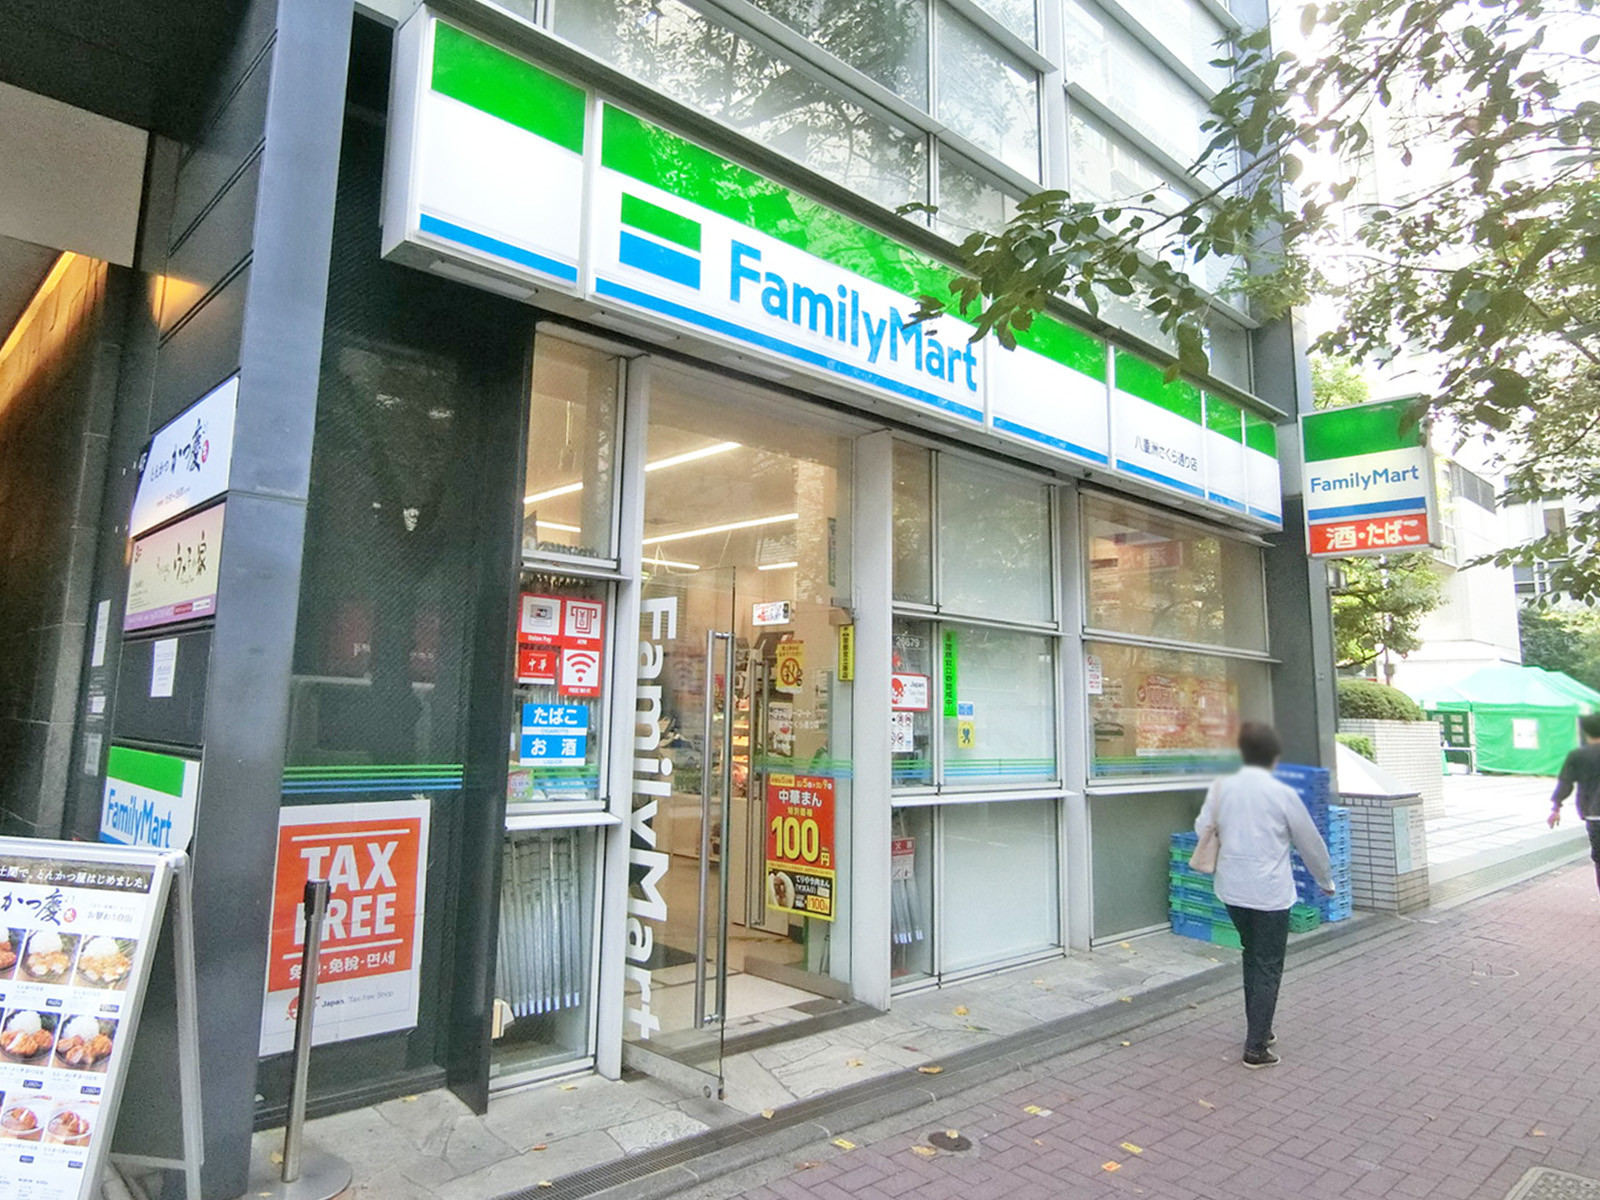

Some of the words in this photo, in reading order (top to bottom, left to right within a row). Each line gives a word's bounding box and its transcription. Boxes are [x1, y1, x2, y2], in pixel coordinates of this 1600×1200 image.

[730, 239, 977, 393] FamilyMart
[1310, 465, 1419, 493] FamilyMart
[1326, 519, 1421, 550] 酒・たばこ
[533, 707, 578, 725] たばこ
[106, 788, 172, 848] FamilyMart
[625, 596, 678, 1040] FamilyMart
[778, 789, 822, 807] 中華まん
[300, 840, 399, 893] TAX
